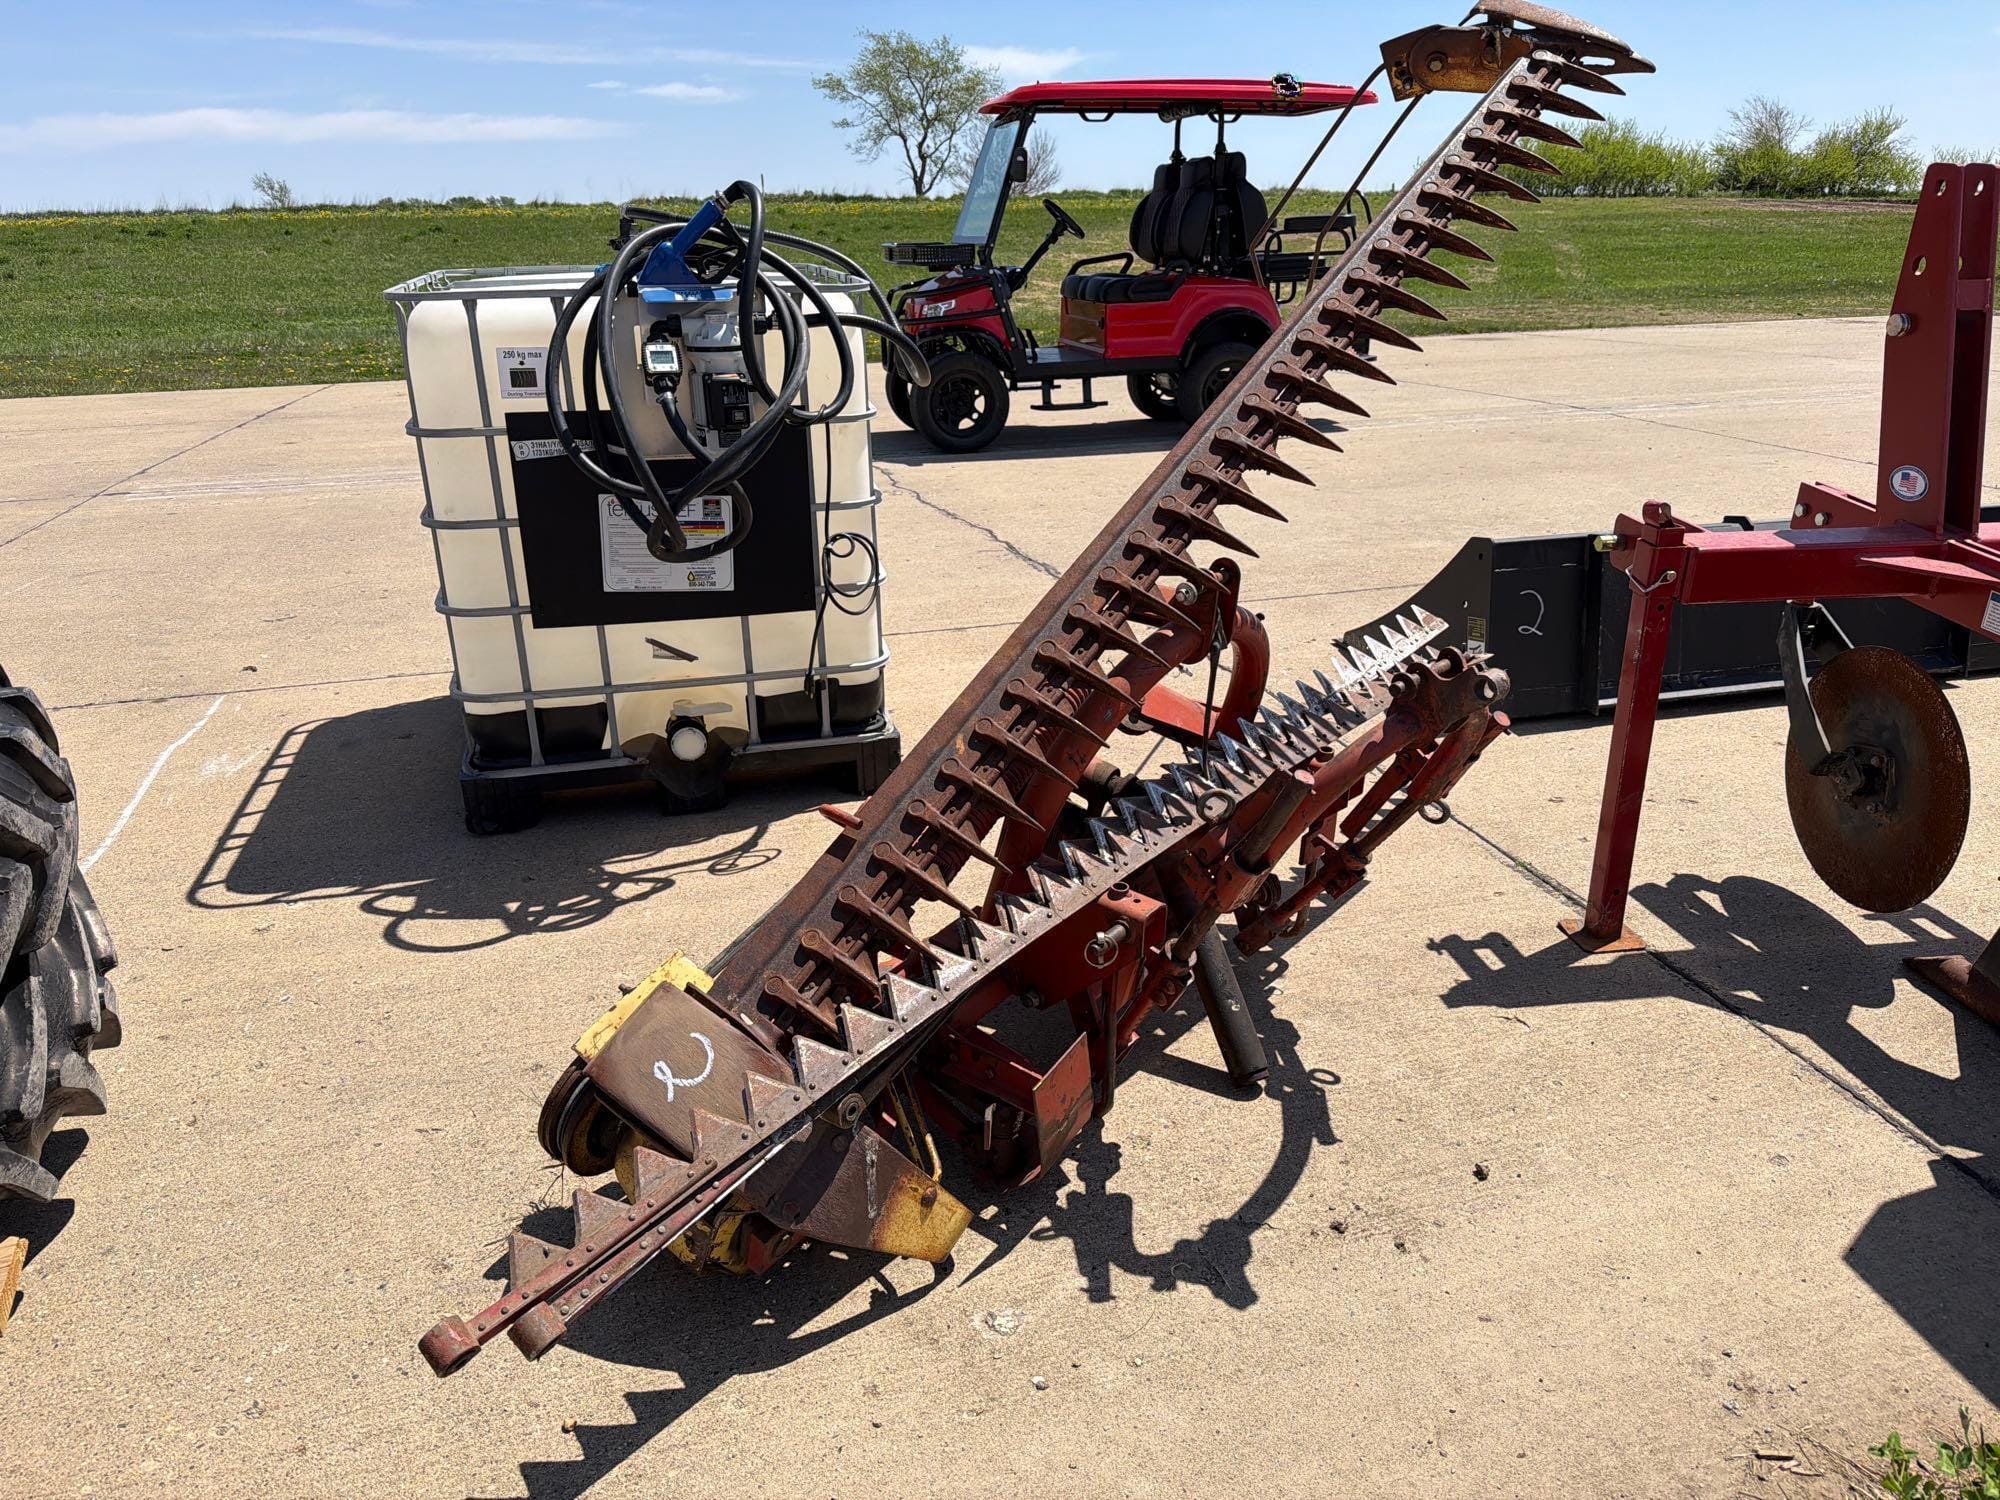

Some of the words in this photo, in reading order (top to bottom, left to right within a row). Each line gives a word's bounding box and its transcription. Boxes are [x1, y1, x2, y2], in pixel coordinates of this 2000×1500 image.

[502, 350, 516, 358] 250
[516, 351, 526, 360] kg
[527, 351, 542, 359] max
[1518, 590, 1545, 636] 2
[652, 1031, 716, 1103] 2
